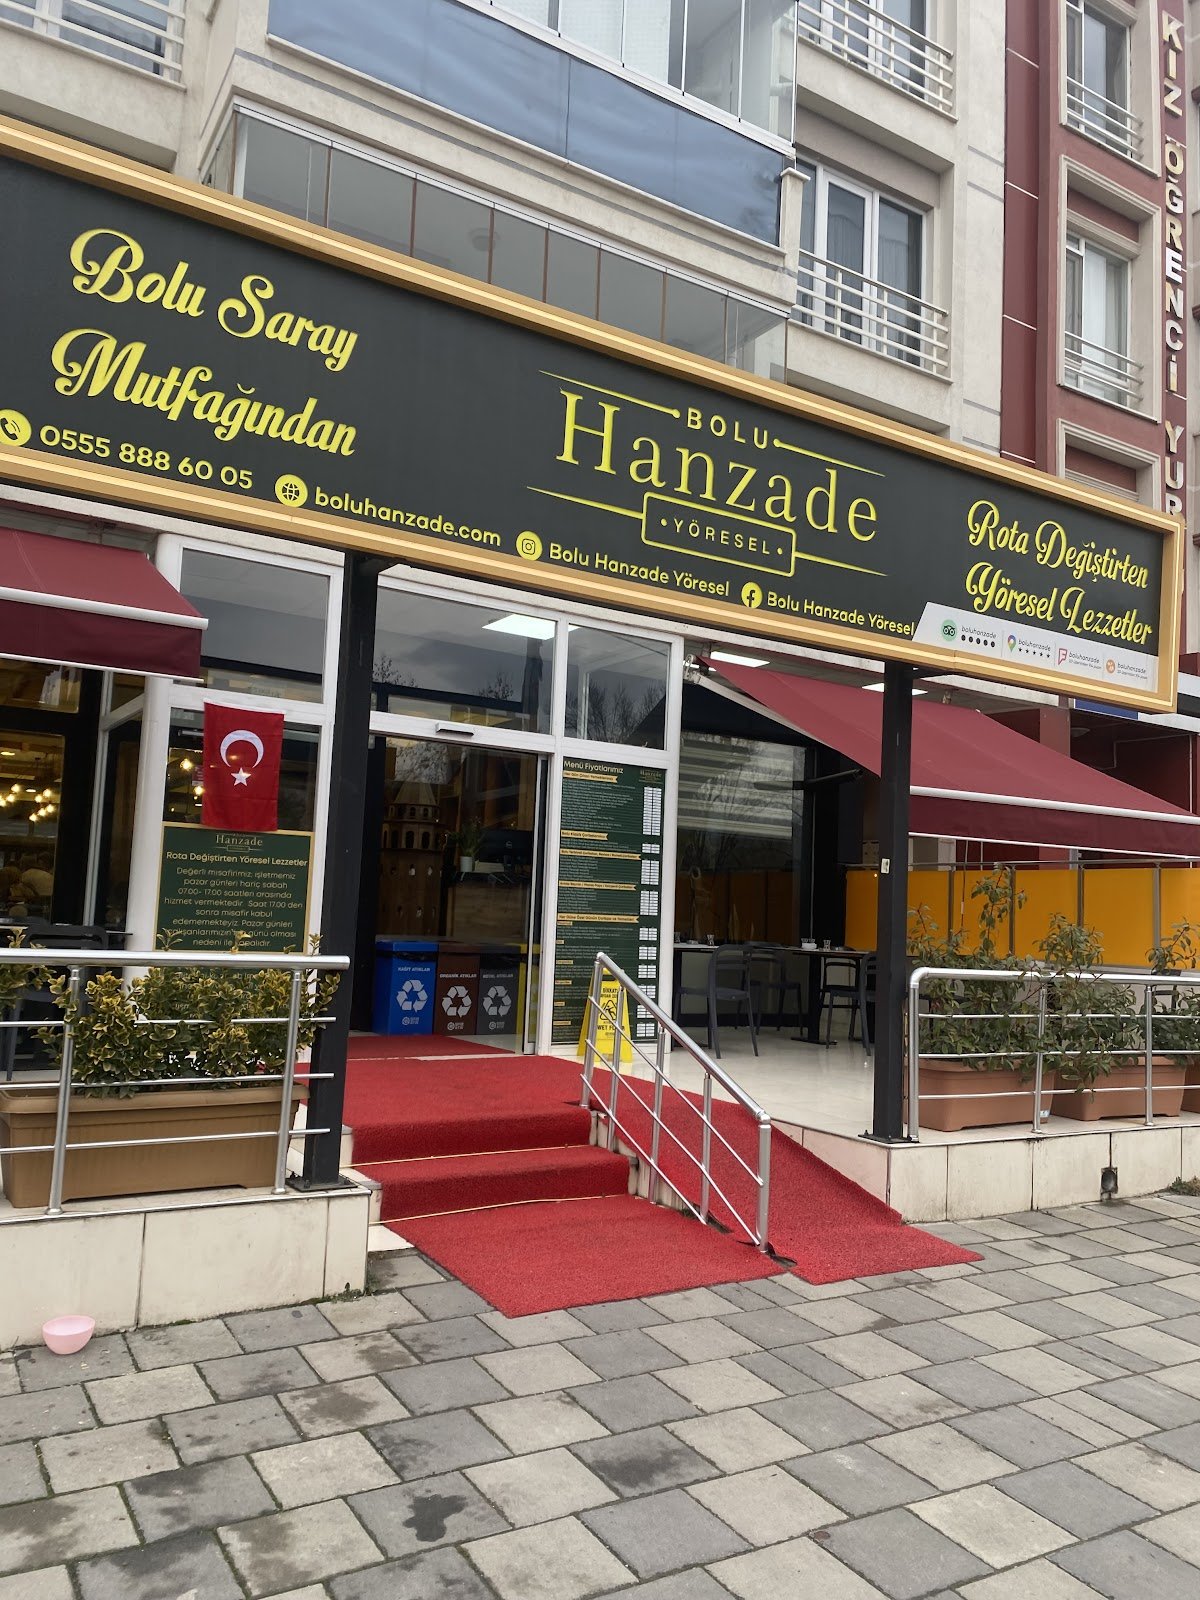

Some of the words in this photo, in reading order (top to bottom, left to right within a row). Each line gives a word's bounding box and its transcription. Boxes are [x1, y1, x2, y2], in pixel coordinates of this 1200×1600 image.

[1165, 135, 1185, 393] ÖĞRENCİ
[70, 228, 207, 317] Bolu
[217, 274, 358, 372] Saray
[51, 328, 357, 456] Mutfağından
[686, 407, 769, 450] BOLU
[40, 425, 111, 457] 0555
[119, 443, 170, 471] 888
[178, 457, 213, 480] 60
[220, 466, 253, 489] 05
[556, 388, 878, 542] Hanzade
[315, 487, 501, 546] boluhanzade.com
[673, 518, 771, 555] YÖRESEL
[967, 500, 1029, 555] Rota
[1035, 520, 1148, 589] Değiştirten
[549, 543, 589, 566] Bolu
[595, 552, 669, 583] Hanzade
[673, 570, 730, 596] Yöresel
[965, 562, 1058, 622] Yöresel
[1060, 587, 1152, 645] Lezzetler
[767, 592, 800, 612] Bolu
[804, 599, 865, 625] Hanzade
[868, 613, 915, 636] Yöresel
[961, 625, 996, 639] boluhanzade
[1018, 638, 1051, 651] boluhanzade
[563, 760, 584, 769] Menü
[585, 762, 624, 774] Fiyatlarımız
[216, 834, 263, 846] Hanzade
[166, 852, 188, 861] Rota
[190, 853, 238, 864] Değiştirten
[239, 855, 270, 864] Yöresel
[272, 857, 308, 867] Lezzetler
[176, 867, 205, 876] Değerli
[184, 879, 208, 888] pazar
[210, 879, 238, 888] günleri
[240, 880, 261, 888] hariç
[262, 881, 287, 889] sabah
[256, 891, 292, 899] arasında
[164, 897, 192, 905] hizmet
[248, 900, 267, 908] Saat
[287, 901, 303, 909] den
[221, 908, 250, 917] misafir
[251, 909, 273, 917] kabul
[265, 920, 293, 929] günleri
[270, 930, 297, 938] olması
[192, 938, 222, 946] nedeni
